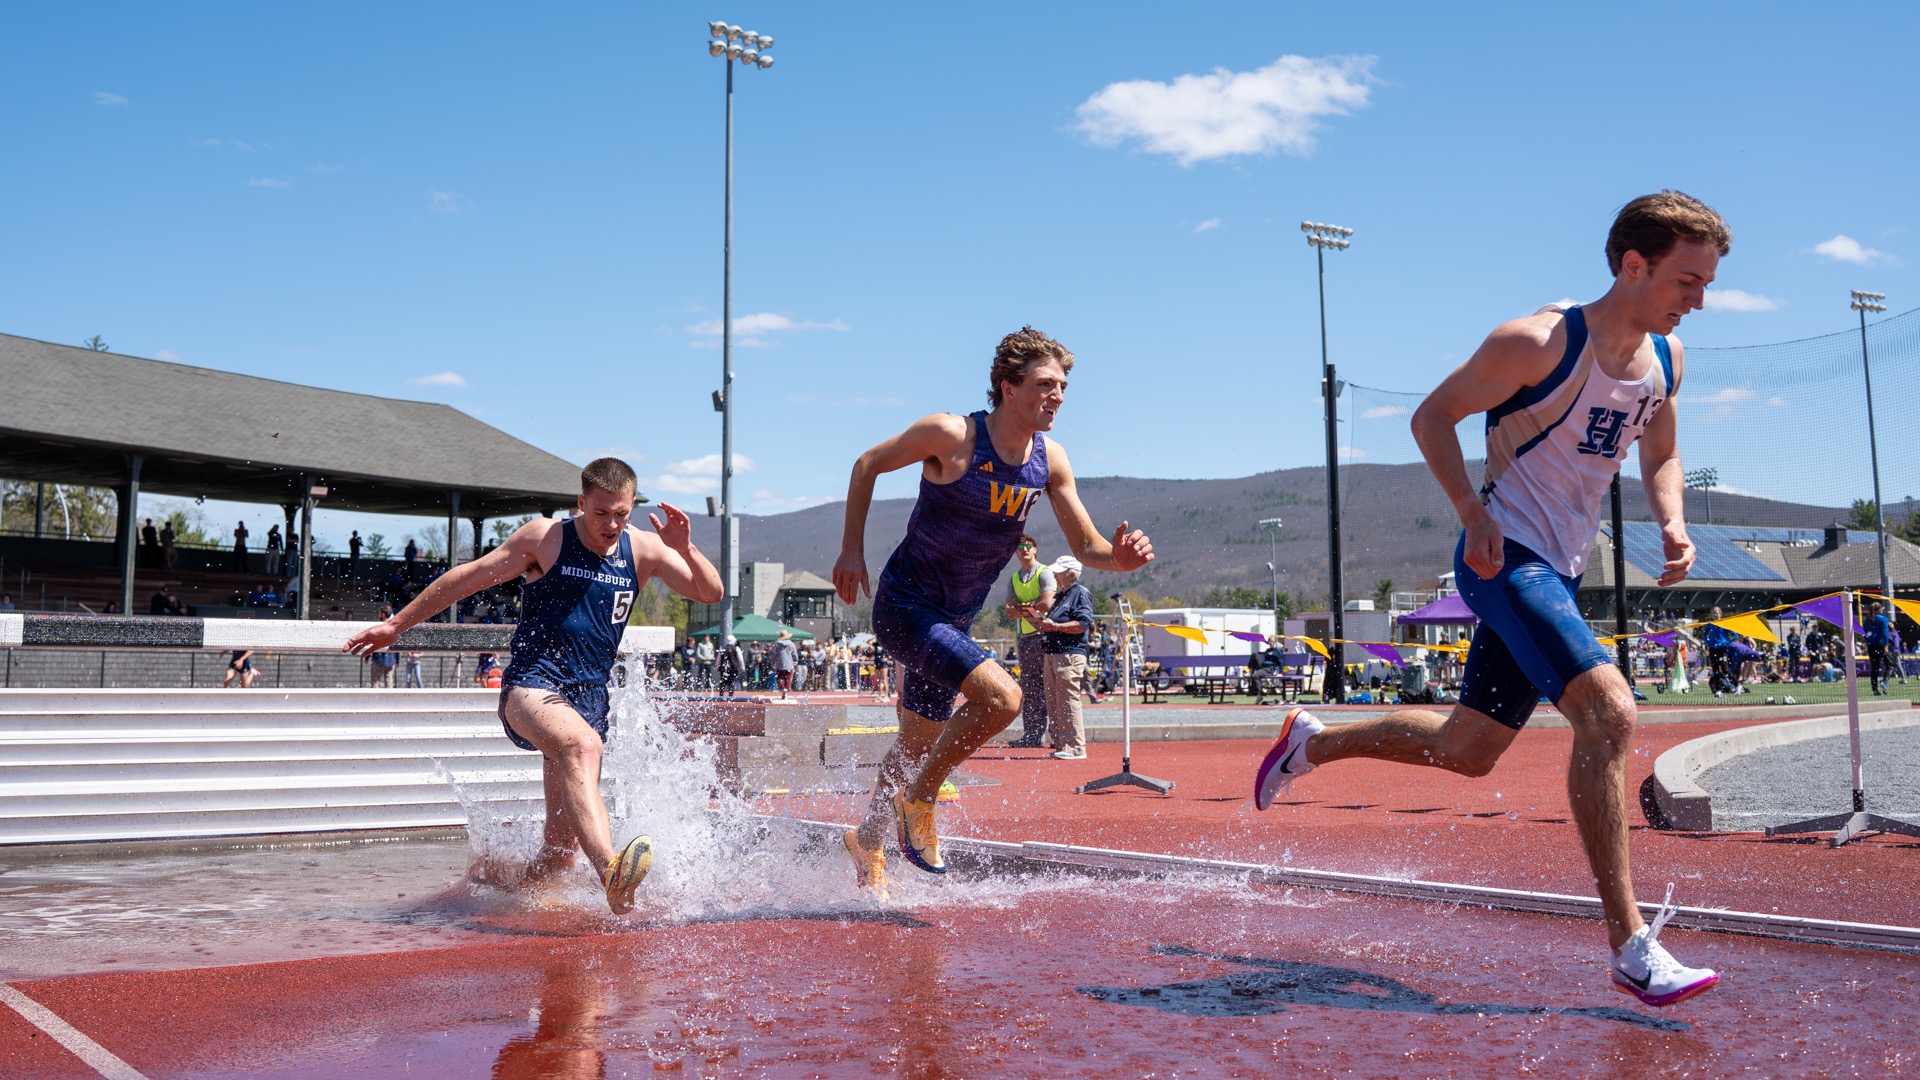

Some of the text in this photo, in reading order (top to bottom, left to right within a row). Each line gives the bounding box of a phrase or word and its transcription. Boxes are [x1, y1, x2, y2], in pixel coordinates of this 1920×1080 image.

[1577, 407, 1629, 458] H
[989, 481, 1029, 517] W
[561, 565, 632, 588] MIDDLEBURY
[613, 592, 631, 621] 5
